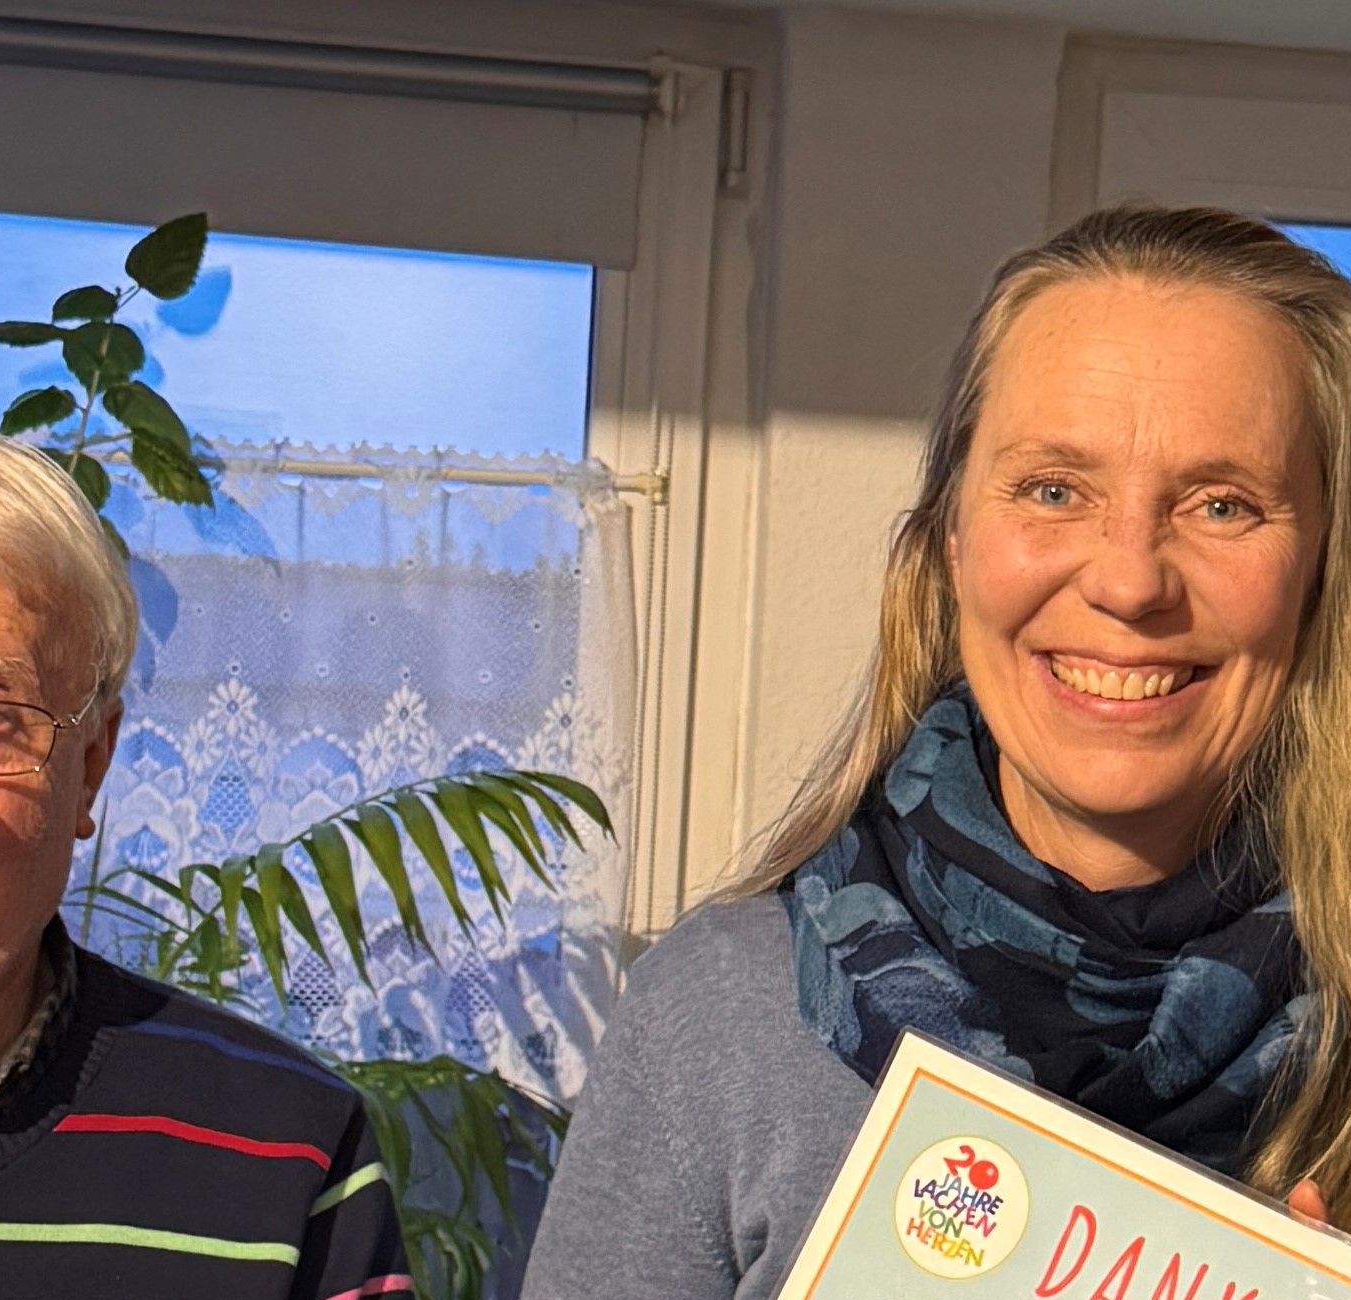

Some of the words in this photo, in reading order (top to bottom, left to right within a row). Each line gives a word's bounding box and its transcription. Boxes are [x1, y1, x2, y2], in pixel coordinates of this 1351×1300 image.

[914, 1179, 997, 1238] LACHEN
[936, 1173, 1004, 1215] JAHRE
[918, 1199, 965, 1238] VON
[906, 1217, 986, 1268] HERZEN
